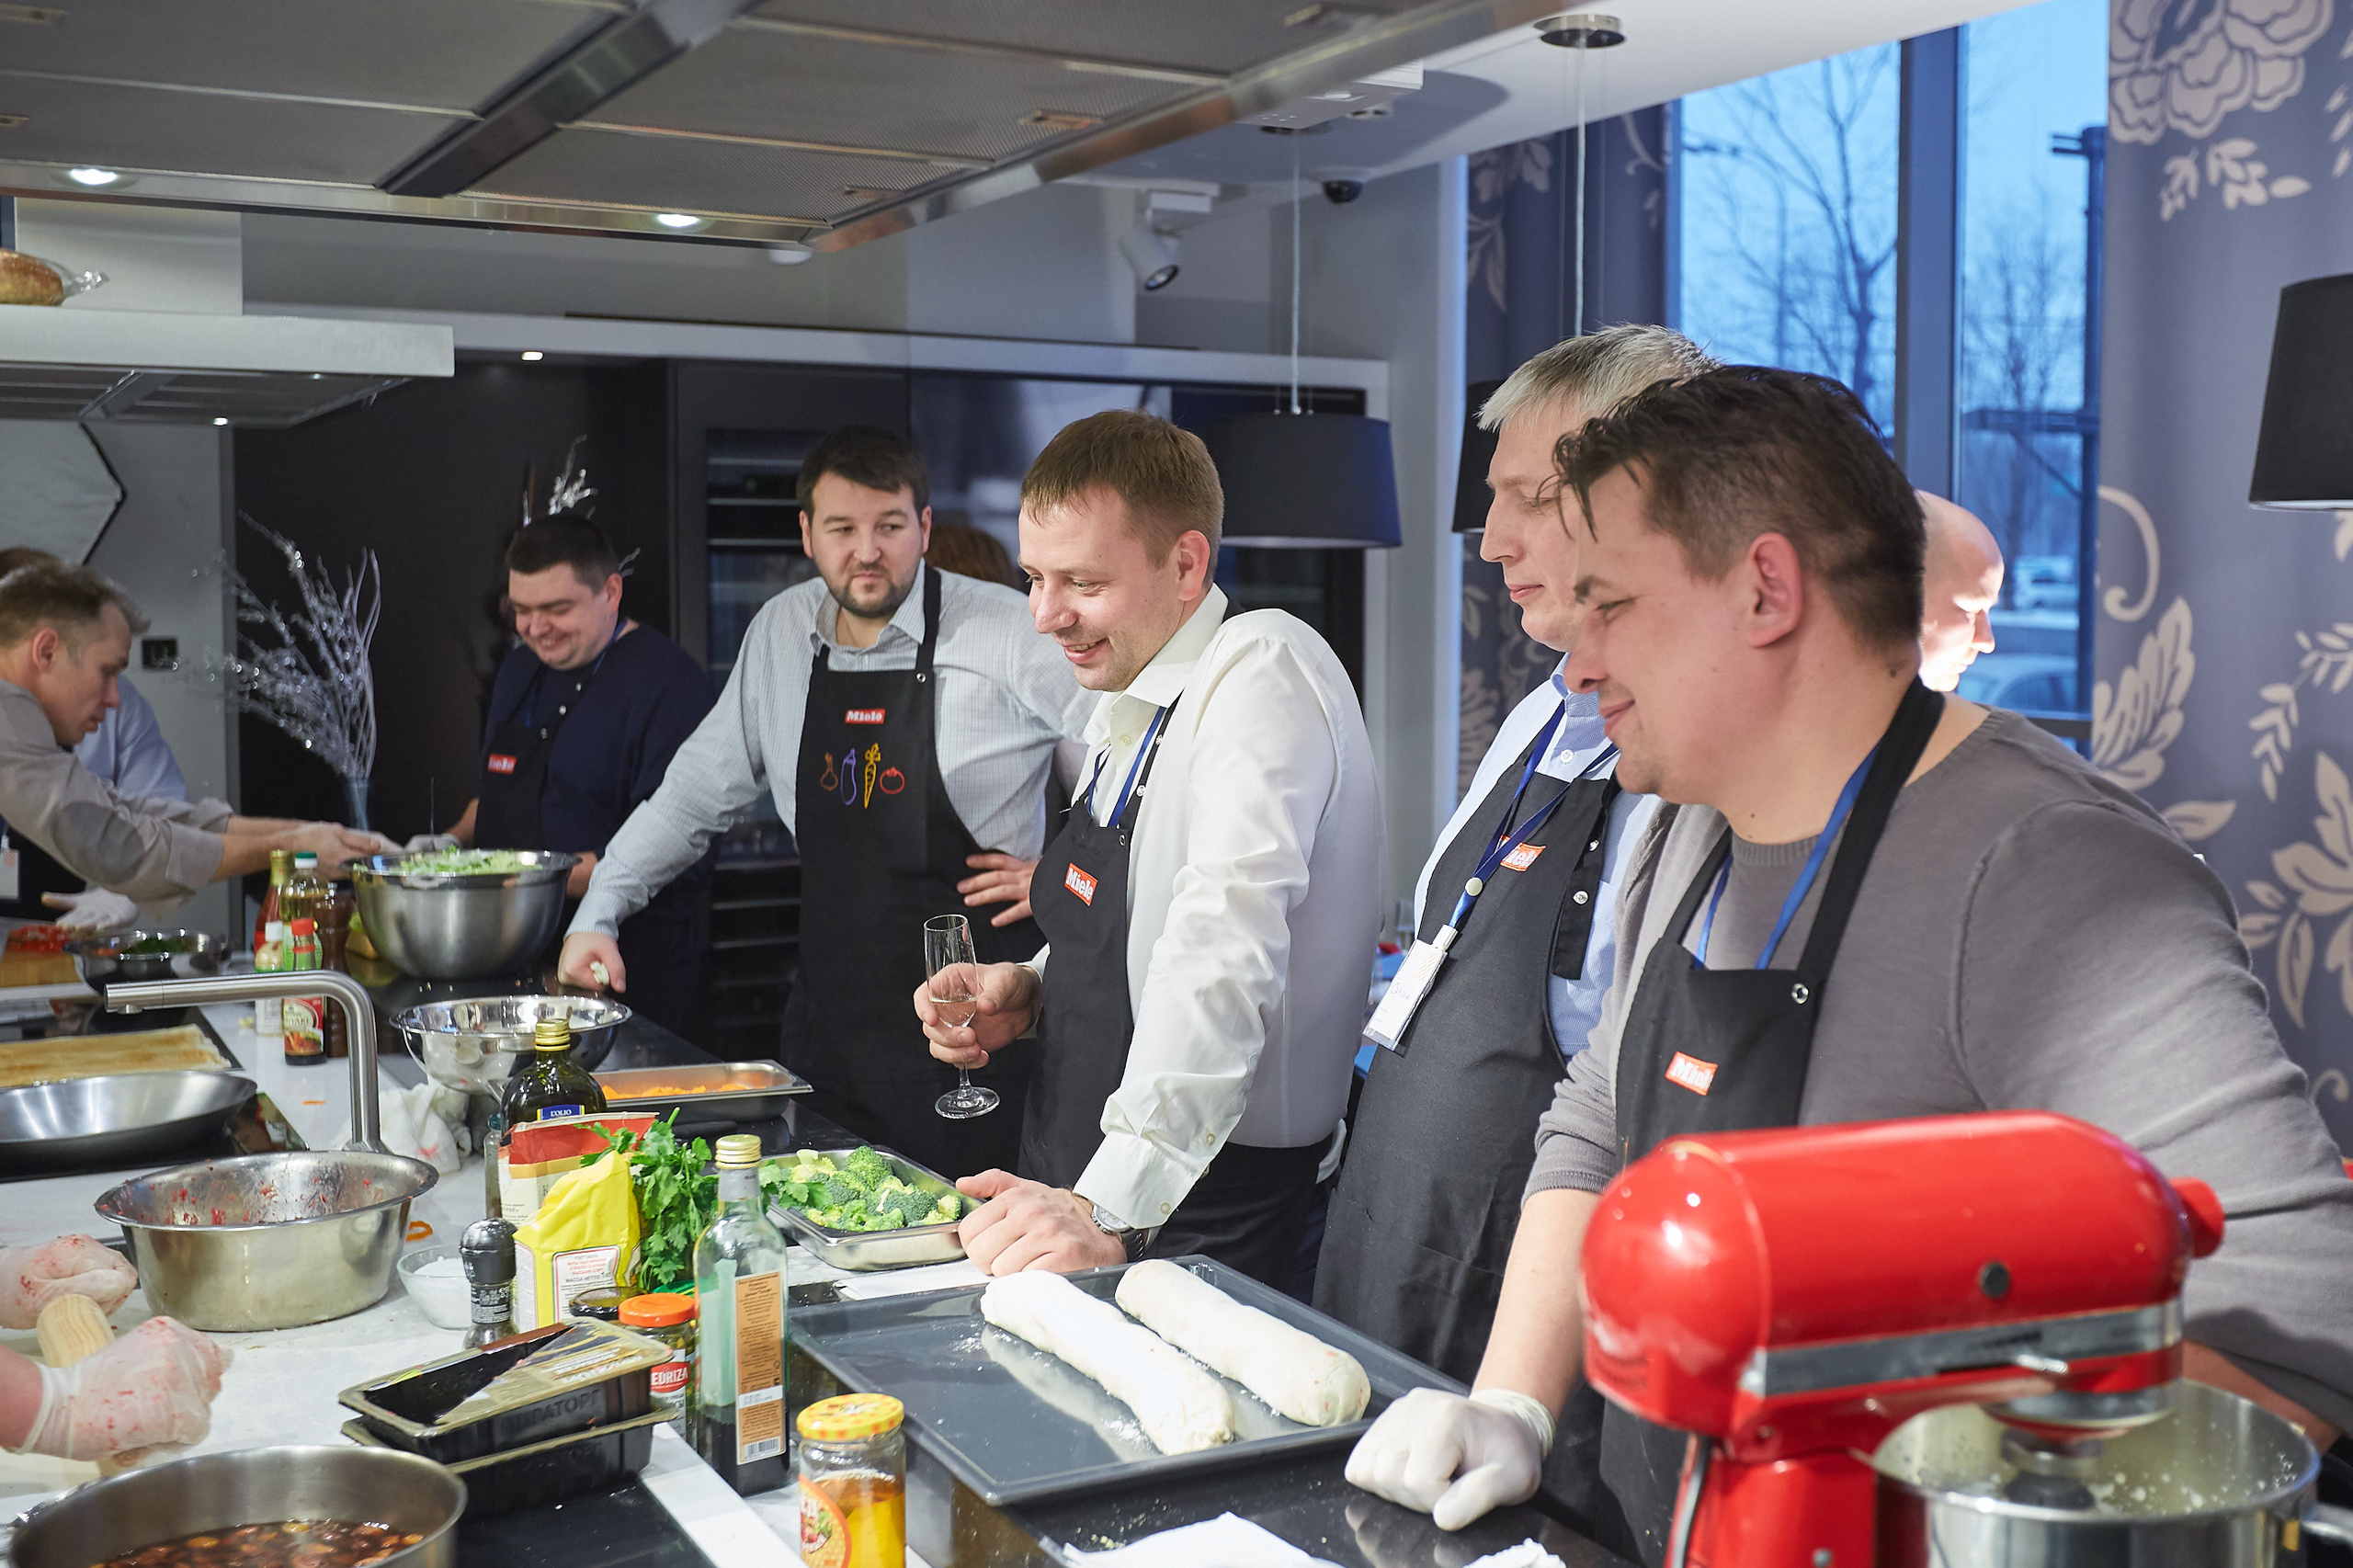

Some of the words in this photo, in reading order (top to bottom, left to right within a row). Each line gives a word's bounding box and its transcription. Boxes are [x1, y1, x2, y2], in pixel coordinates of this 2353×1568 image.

[847, 710, 883, 722] Miele
[1065, 867, 1094, 901] Miele
[651, 1366, 688, 1386] EDRIZA
